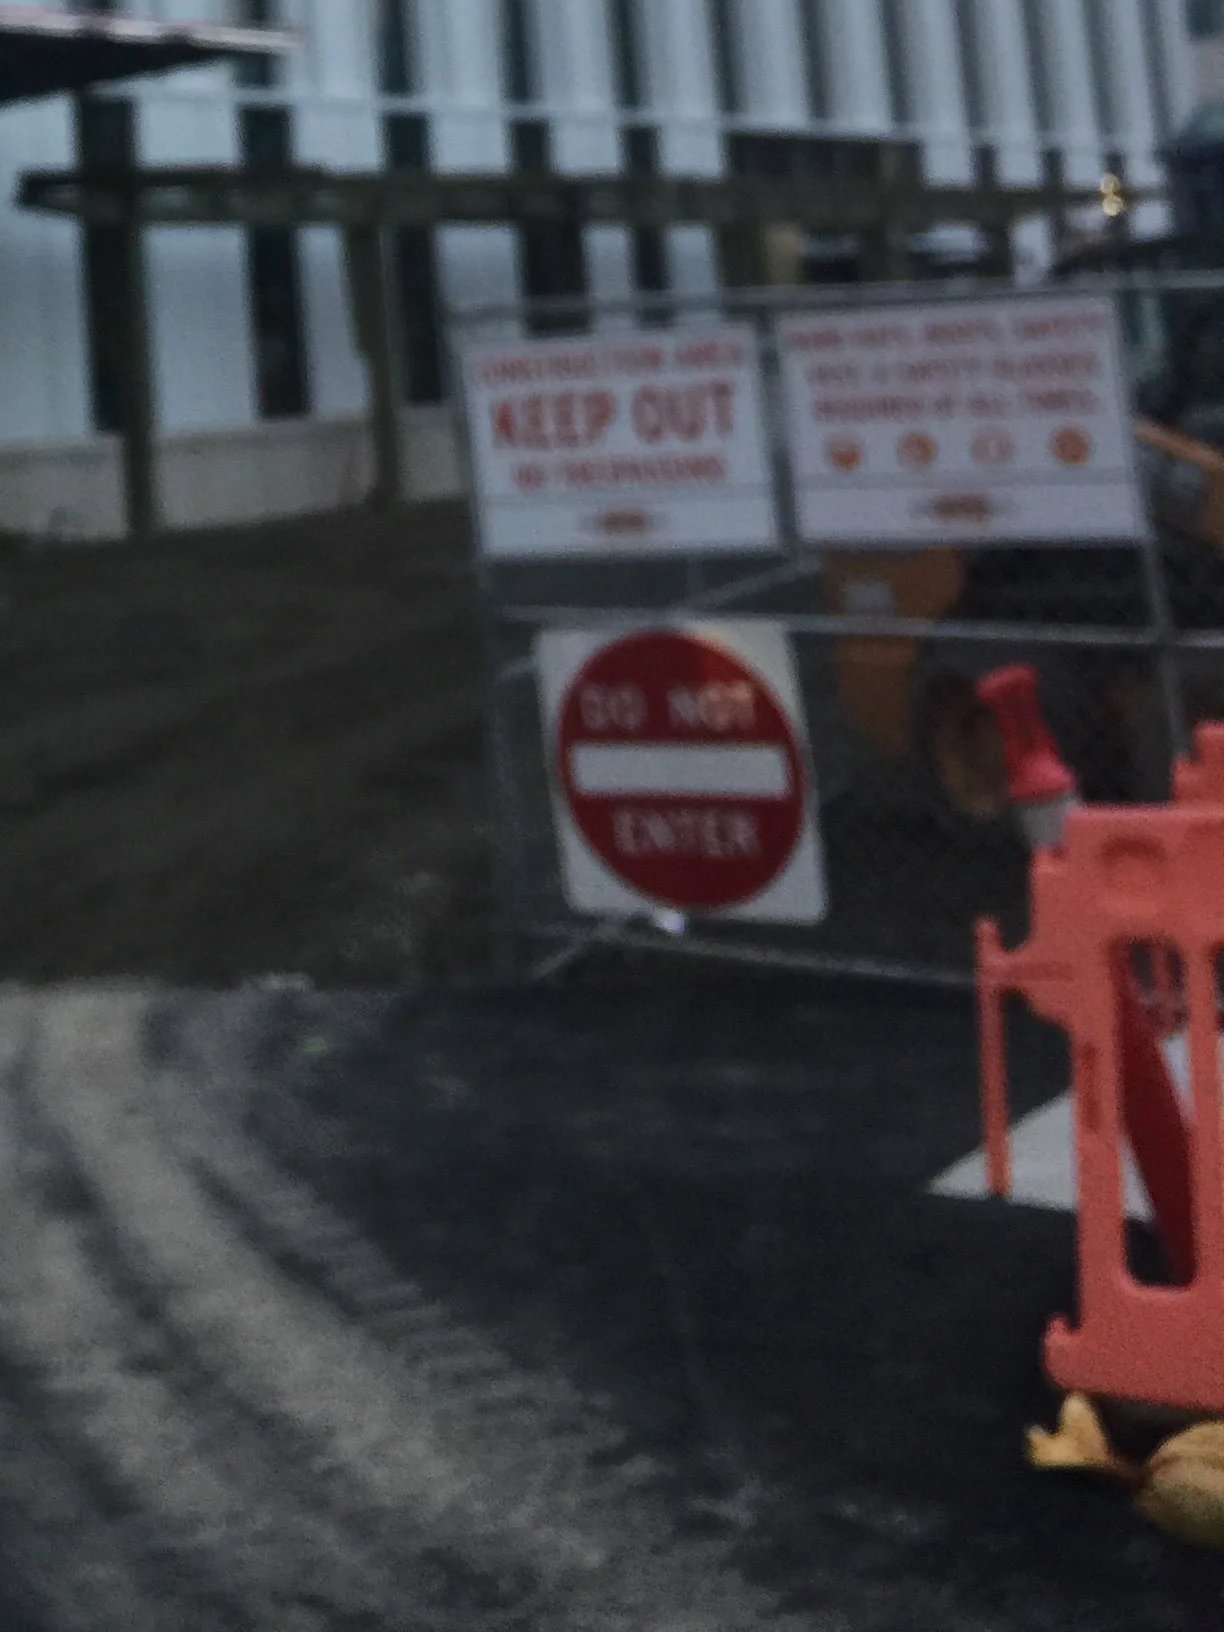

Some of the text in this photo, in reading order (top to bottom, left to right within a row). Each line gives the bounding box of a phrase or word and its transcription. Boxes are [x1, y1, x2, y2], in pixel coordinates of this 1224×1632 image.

[491, 379, 735, 449] KEEP OUT
[580, 680, 757, 731] DO NOT
[612, 808, 760, 858] ENTER
